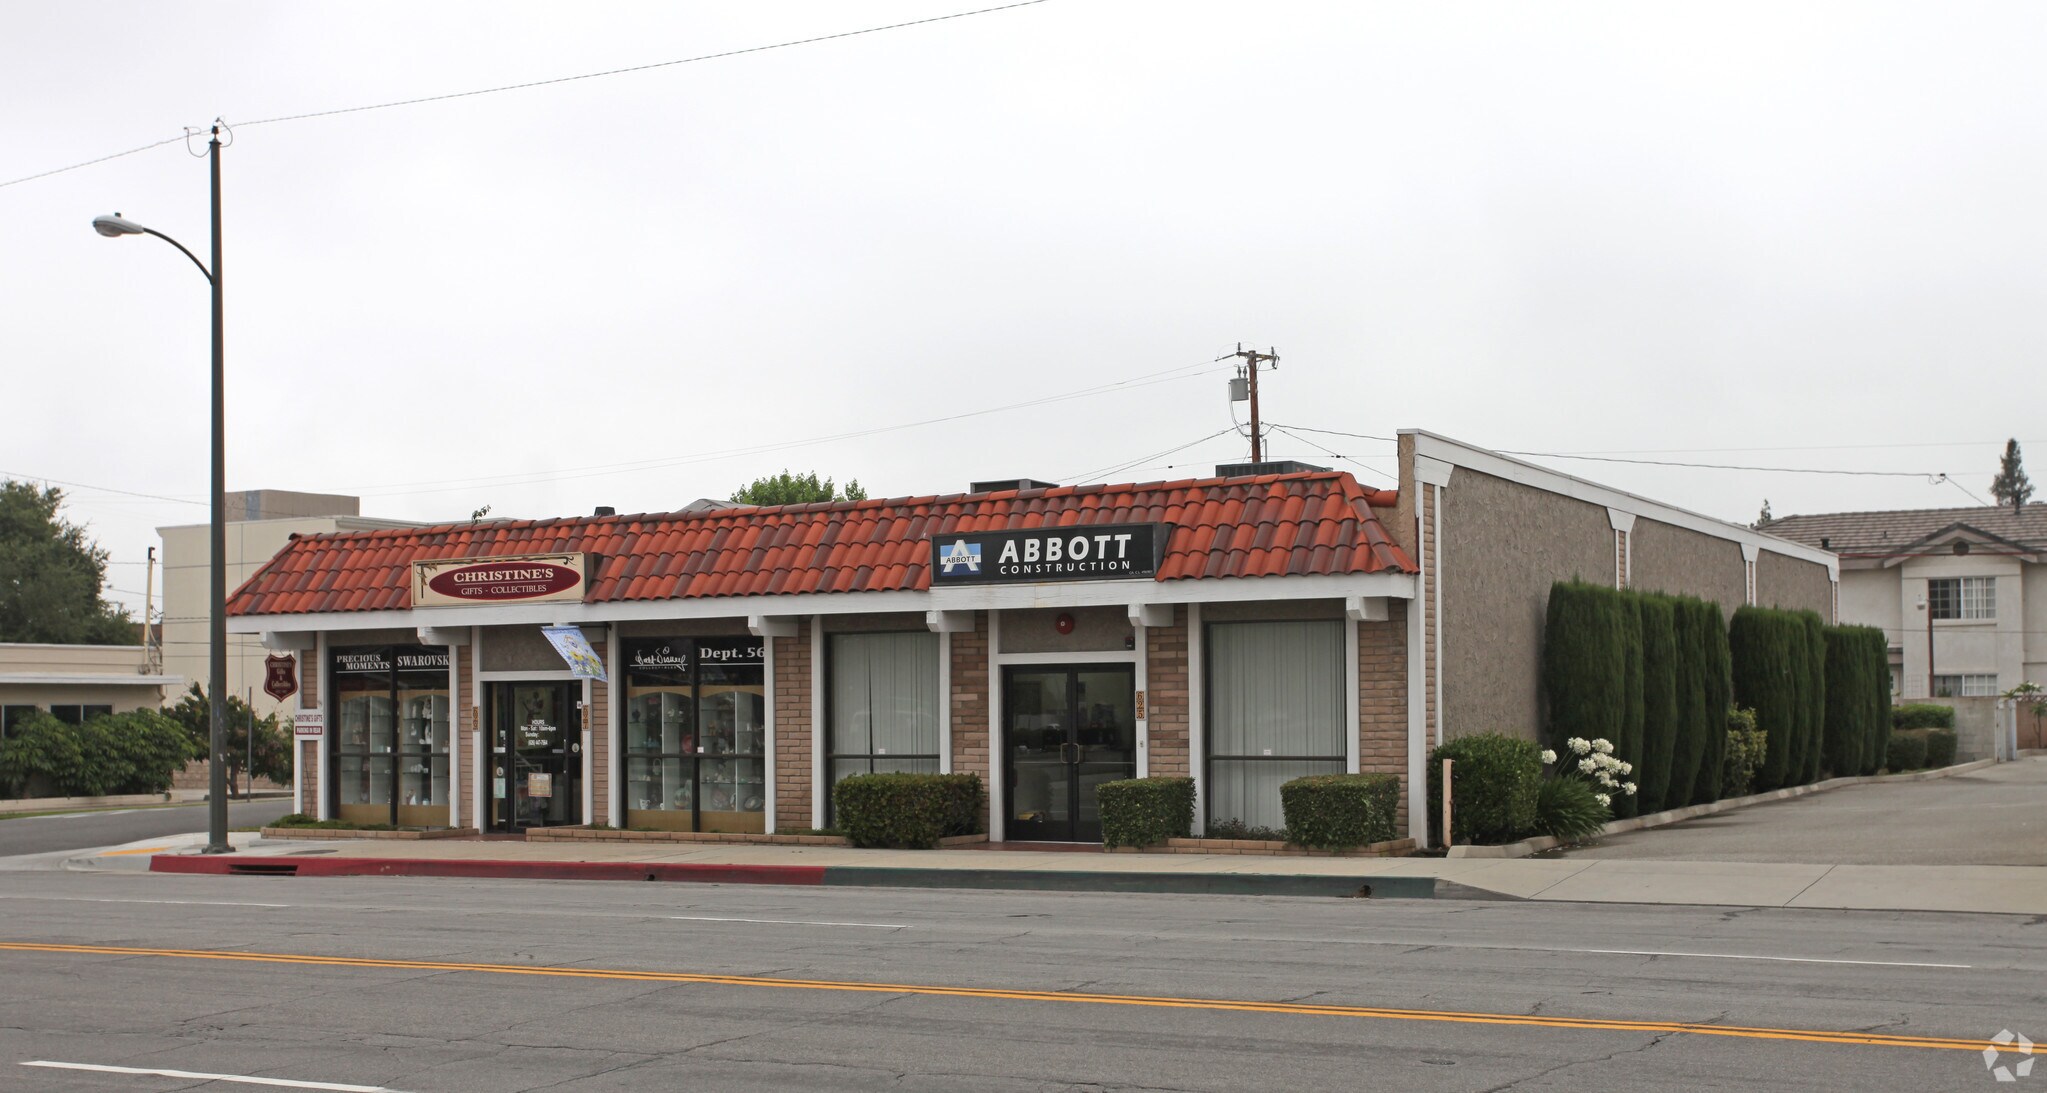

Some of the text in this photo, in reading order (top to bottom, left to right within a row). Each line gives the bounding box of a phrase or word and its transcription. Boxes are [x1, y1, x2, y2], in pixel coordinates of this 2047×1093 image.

[998, 534, 1132, 563] ABBOTT
[945, 555, 976, 563] ABBOTT
[1000, 561, 1130, 574] CONSTRUCTION
[453, 568, 554, 583] CHRISTINE'S
[461, 587, 483, 595] GIFTS
[491, 584, 547, 594] COLLECTIBLES
[336, 654, 381, 663] PRECIOUS
[700, 646, 764, 660] Dept. 56
[346, 661, 390, 670] MOMENTS
